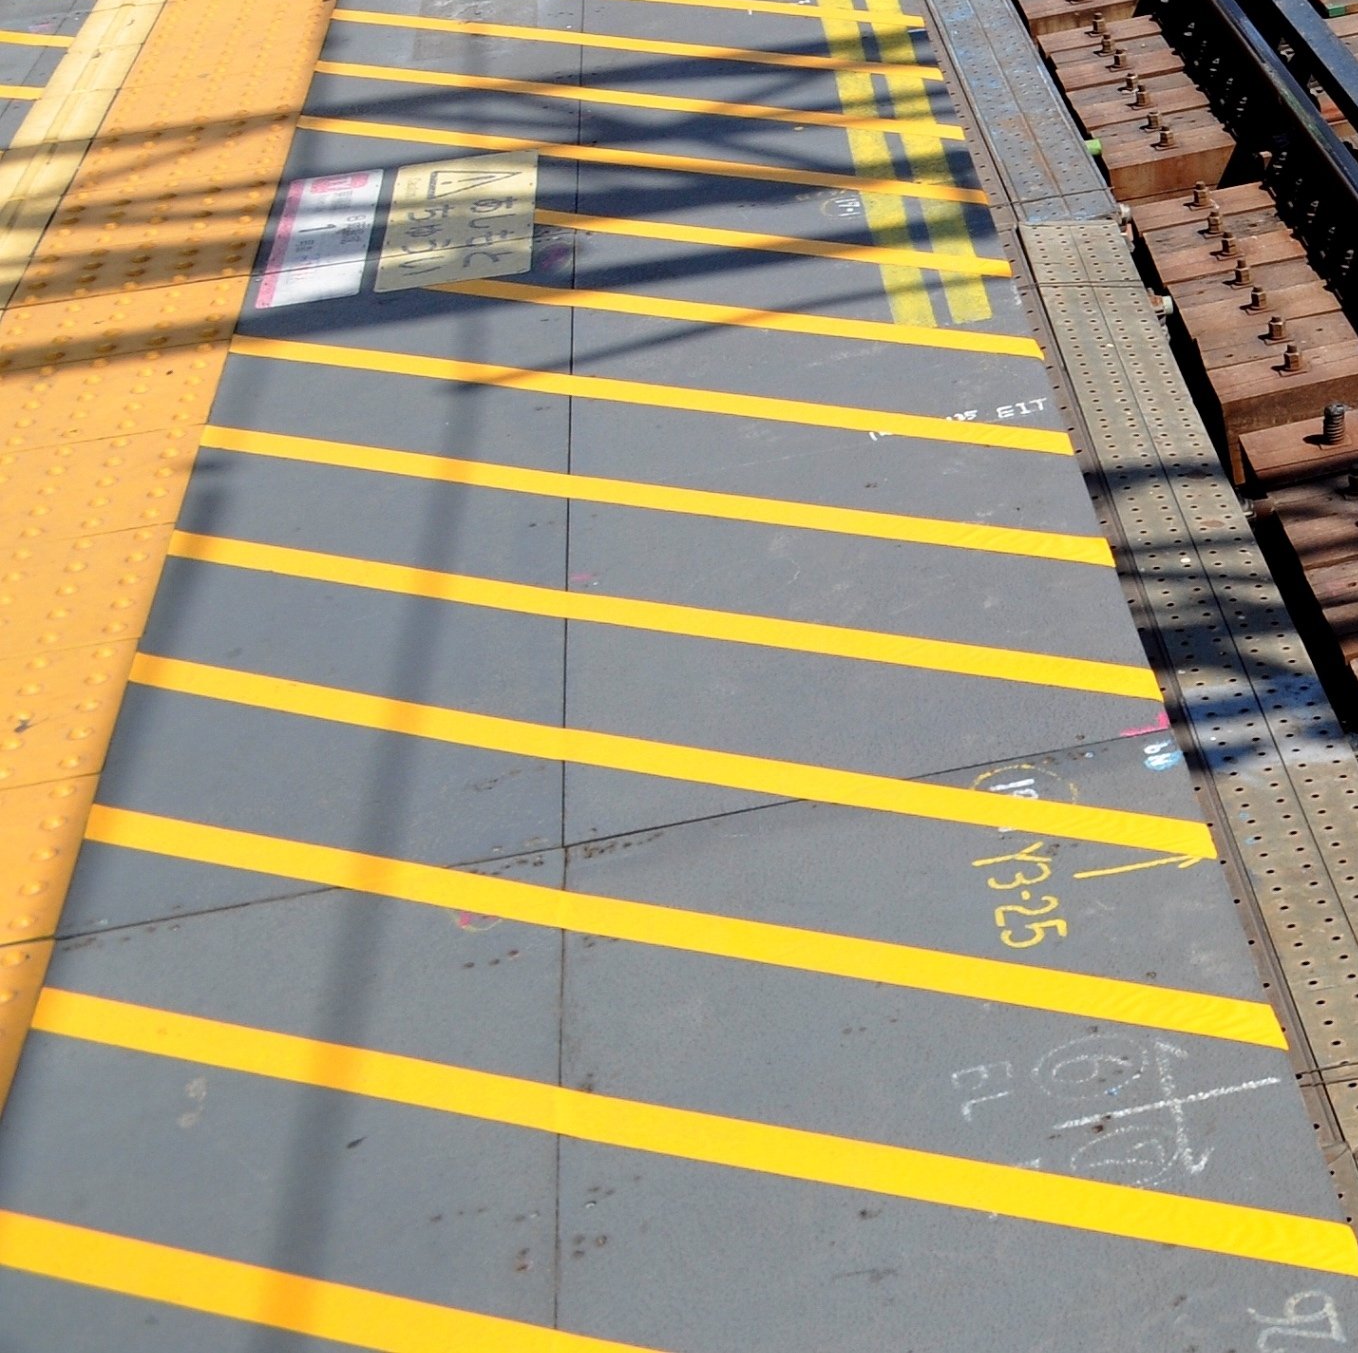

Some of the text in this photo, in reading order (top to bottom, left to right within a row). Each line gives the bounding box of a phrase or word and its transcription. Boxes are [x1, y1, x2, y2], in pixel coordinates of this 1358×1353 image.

[400, 204, 455, 278] ちゅうい
[462, 196, 518, 269] あしもと
